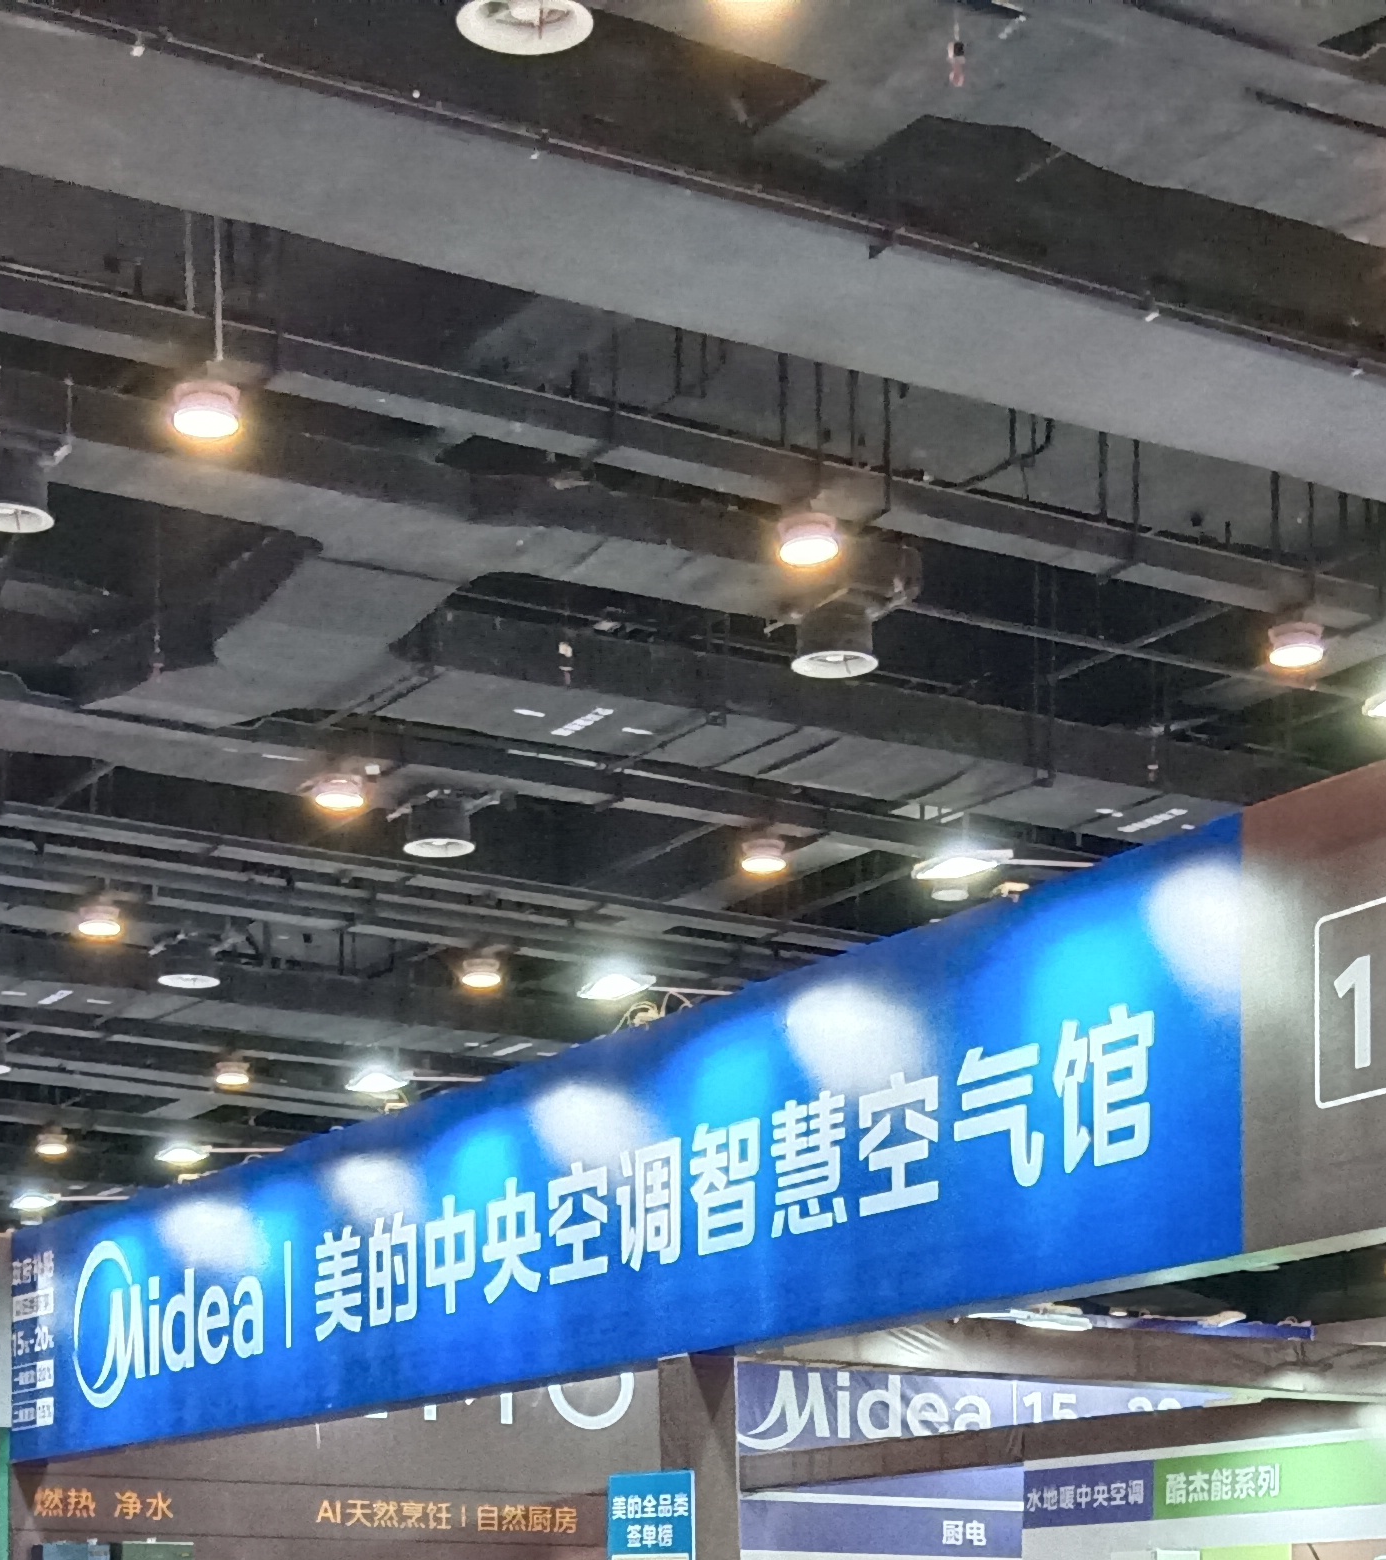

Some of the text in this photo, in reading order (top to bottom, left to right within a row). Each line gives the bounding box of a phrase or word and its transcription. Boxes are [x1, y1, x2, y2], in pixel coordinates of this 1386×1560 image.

[73, 1003, 1156, 1409] Midea 美的中央空调智慧空气馆
[737, 1370, 992, 1451] Midea
[33, 1487, 174, 1522] 燃热 净水
[611, 1492, 689, 1521] 美的全品类
[1025, 1478, 1145, 1513] 水地暖中央空调
[476, 1504, 578, 1535] 自然厨房
[941, 1519, 987, 1547] 厨电
